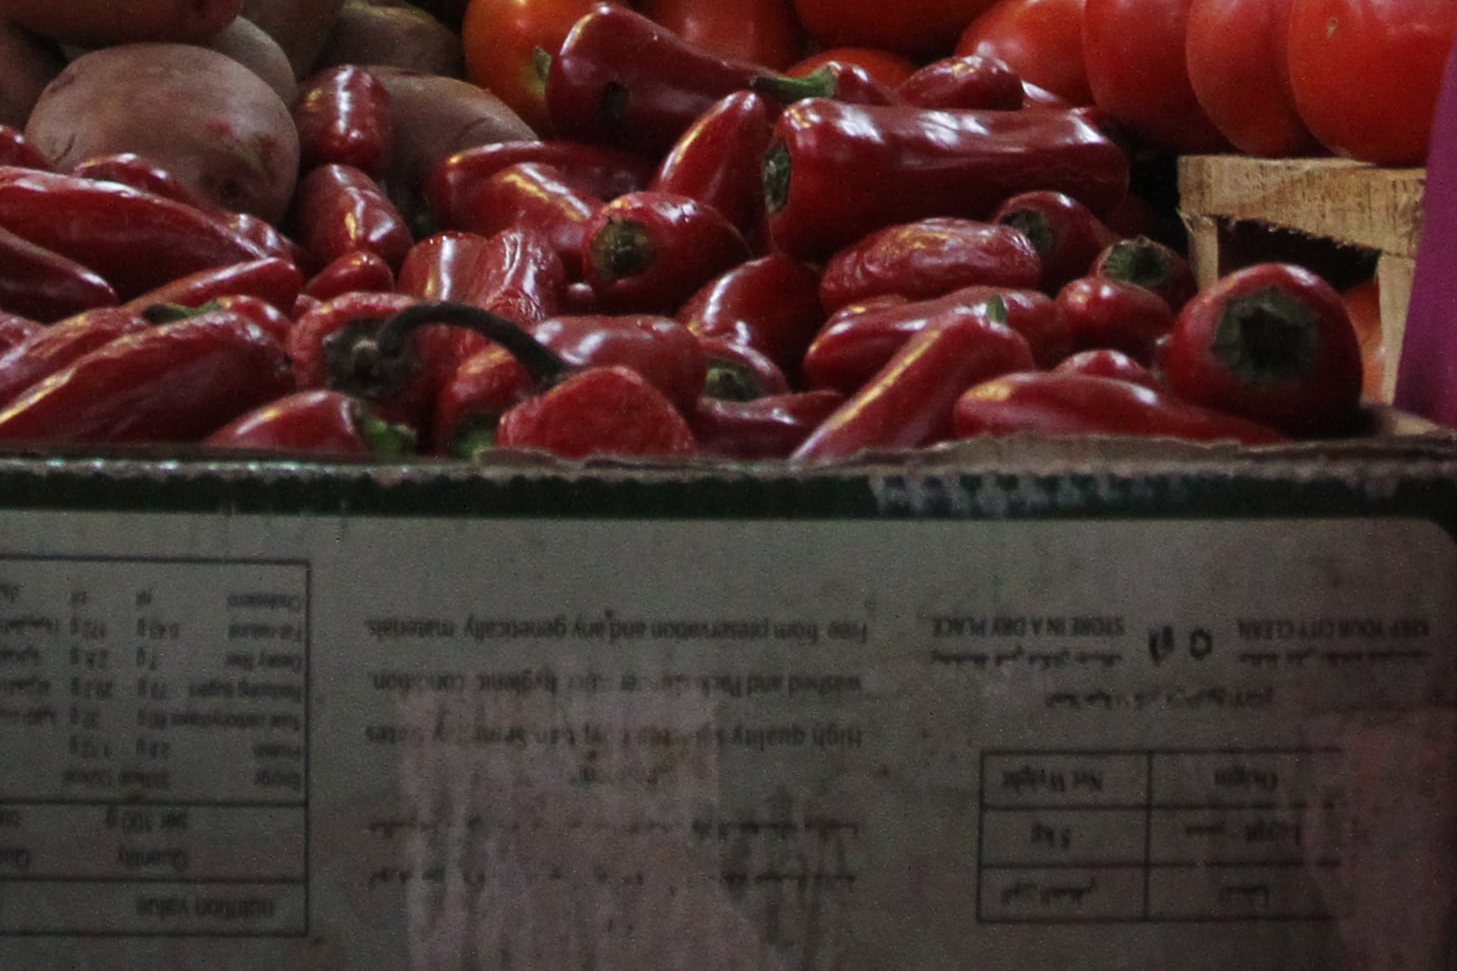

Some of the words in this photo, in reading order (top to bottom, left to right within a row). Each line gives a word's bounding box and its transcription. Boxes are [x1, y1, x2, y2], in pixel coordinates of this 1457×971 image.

[463, 613, 568, 642] genetically
[572, 614, 606, 639] any
[608, 621, 647, 644] and
[651, 617, 769, 644] preservation
[772, 621, 819, 645] from
[991, 616, 1026, 637] DRY
[1030, 617, 1044, 638] A
[1046, 617, 1067, 638] IN
[1071, 616, 1125, 638] STORE
[1237, 618, 1295, 640] CLEAN
[1297, 619, 1336, 641] CITY
[1338, 618, 1385, 640] YOUR
[746, 675, 783, 697] and
[788, 675, 862, 697] washed
[729, 724, 806, 752] quality
[812, 724, 863, 749] High
[1002, 766, 1066, 795] Weight
[1072, 771, 1104, 793] Net
[1214, 766, 1279, 793] Origin
[1030, 823, 1055, 851] kg
[115, 845, 188, 872] Quantity
[135, 897, 189, 921] value
[195, 898, 276, 920] nutrition
